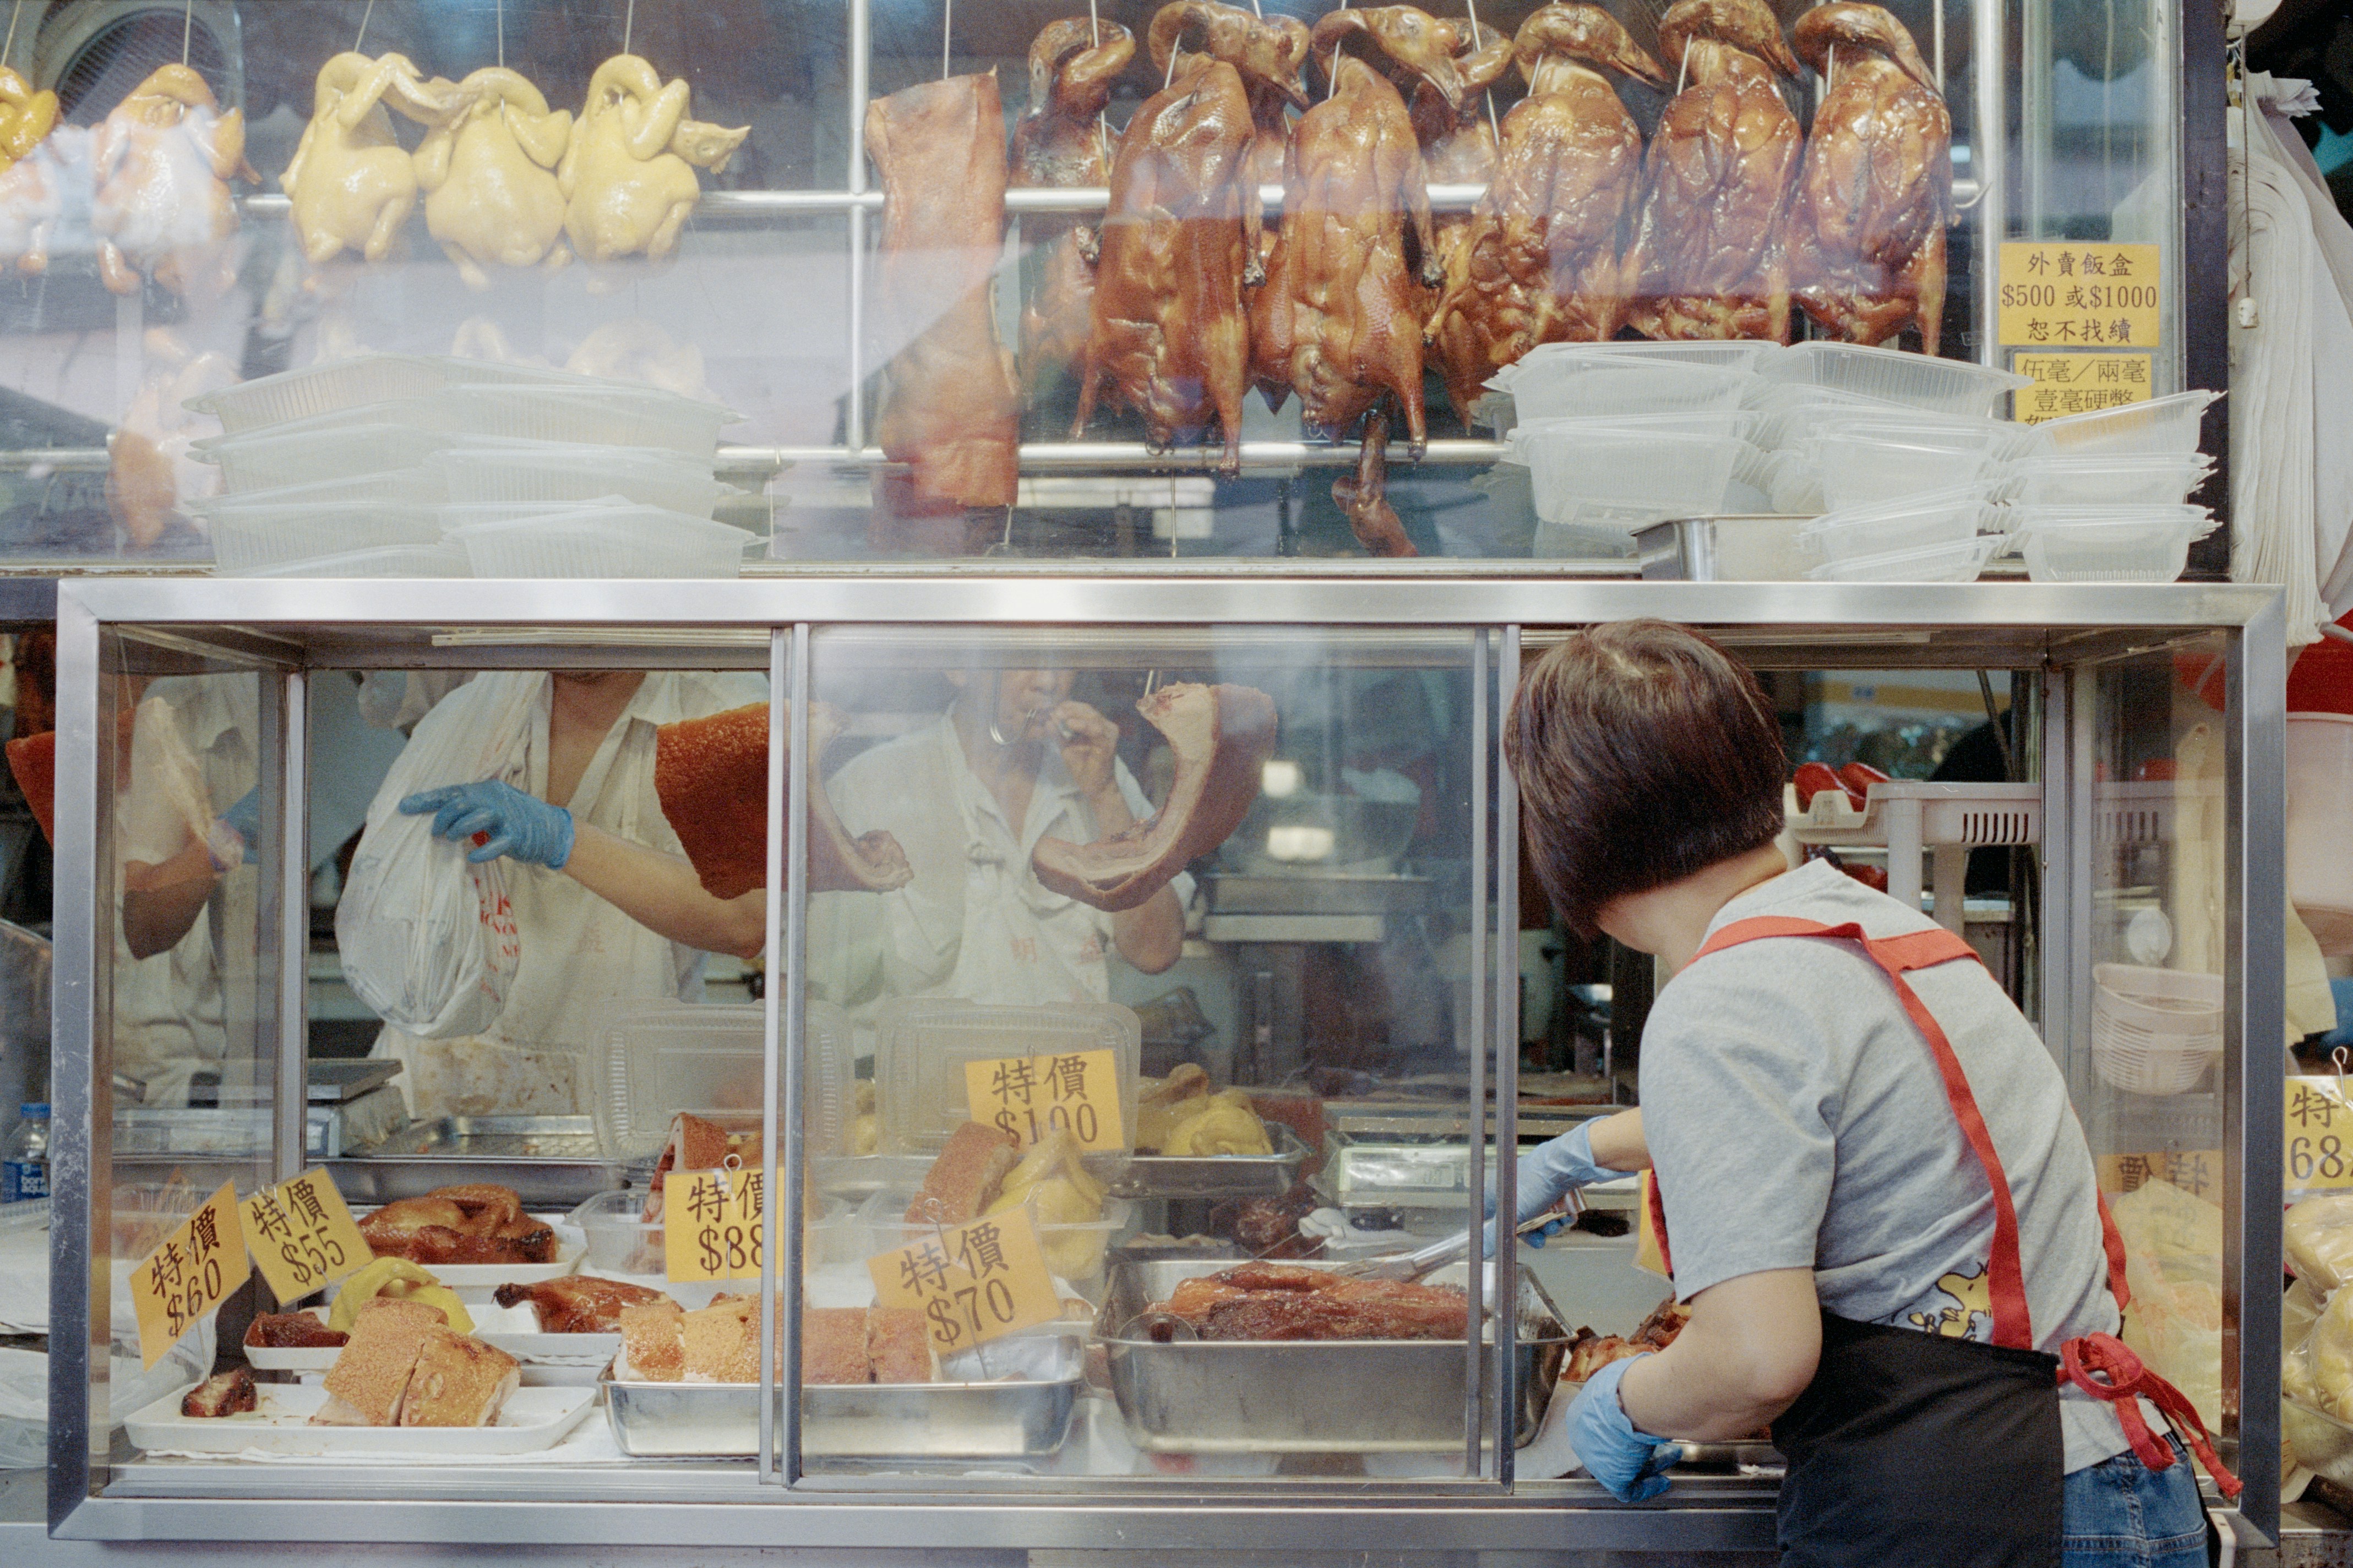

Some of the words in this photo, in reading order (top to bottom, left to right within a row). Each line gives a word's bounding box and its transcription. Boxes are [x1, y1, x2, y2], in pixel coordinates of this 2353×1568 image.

[2028, 250, 2134, 277] 外賣飯盒
[2001, 283, 2055, 308] $500
[2028, 317, 2132, 343] 恕不找續
[991, 1055, 1088, 1106] 特價
[994, 1102, 1098, 1149] $100
[251, 1179, 330, 1243] 特價
[687, 1172, 762, 1223] 特價
[151, 1204, 220, 1298] 特價
[281, 1226, 345, 1286] $55
[699, 1224, 762, 1276] $88
[900, 1221, 1010, 1297] 特價
[166, 1258, 222, 1338] $60
[927, 1277, 1015, 1346] $70
